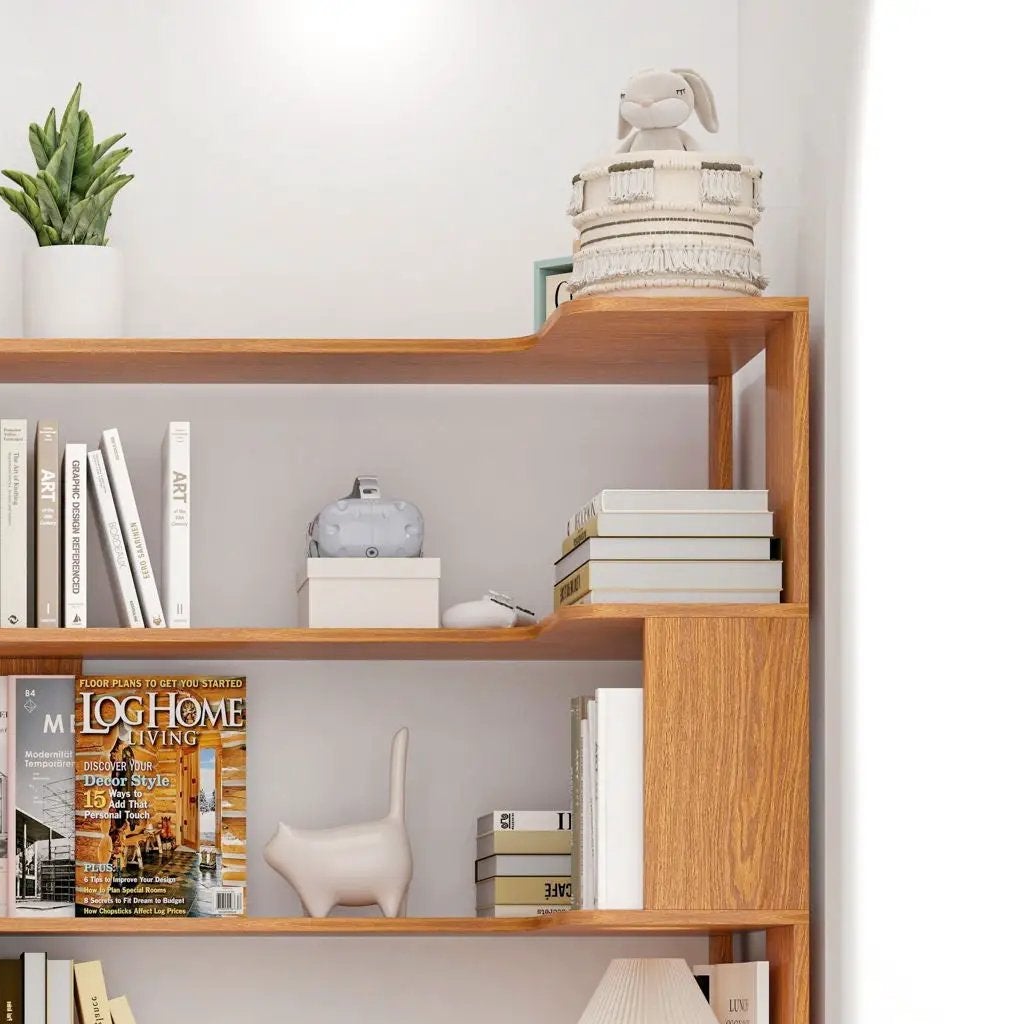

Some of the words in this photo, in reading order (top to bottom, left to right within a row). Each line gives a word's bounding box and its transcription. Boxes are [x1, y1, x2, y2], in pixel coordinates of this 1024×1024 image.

[72, 460, 80, 499] GRAPHIC
[40, 468, 56, 502] ART
[172, 470, 187, 503] ART
[72, 501, 80, 534] DESIGN
[72, 536, 80, 595] REFERENCED
[79, 679, 109, 688] FLOOR
[112, 679, 142, 688] PLANS
[144, 679, 157, 688] TO
[159, 679, 178, 688] GET
[180, 679, 199, 688] YOU
[202, 679, 243, 688] STARTED
[128, 730, 199, 746] LIVING
[84, 761, 126, 772] DISCOVER
[129, 761, 153, 772] YOUR
[83, 774, 128, 786] Decor
[131, 774, 170, 788] Style
[83, 790, 107, 808] 15
[108, 789, 131, 799] Ways
[134, 789, 143, 798] to
[108, 800, 125, 810] Add
[128, 800, 148, 810] That
[84, 810, 122, 820] Personal
[124, 810, 150, 820] Touch
[83, 864, 116, 872] PLUS:
[90, 876, 103, 884] Tips
[112, 876, 138, 884] Improve
[155, 876, 177, 884] Design
[122, 887, 144, 895] Special
[163, 897, 185, 905] Budget
[98, 907, 132, 916] Chopsticks
[154, 908, 166, 916] Log
